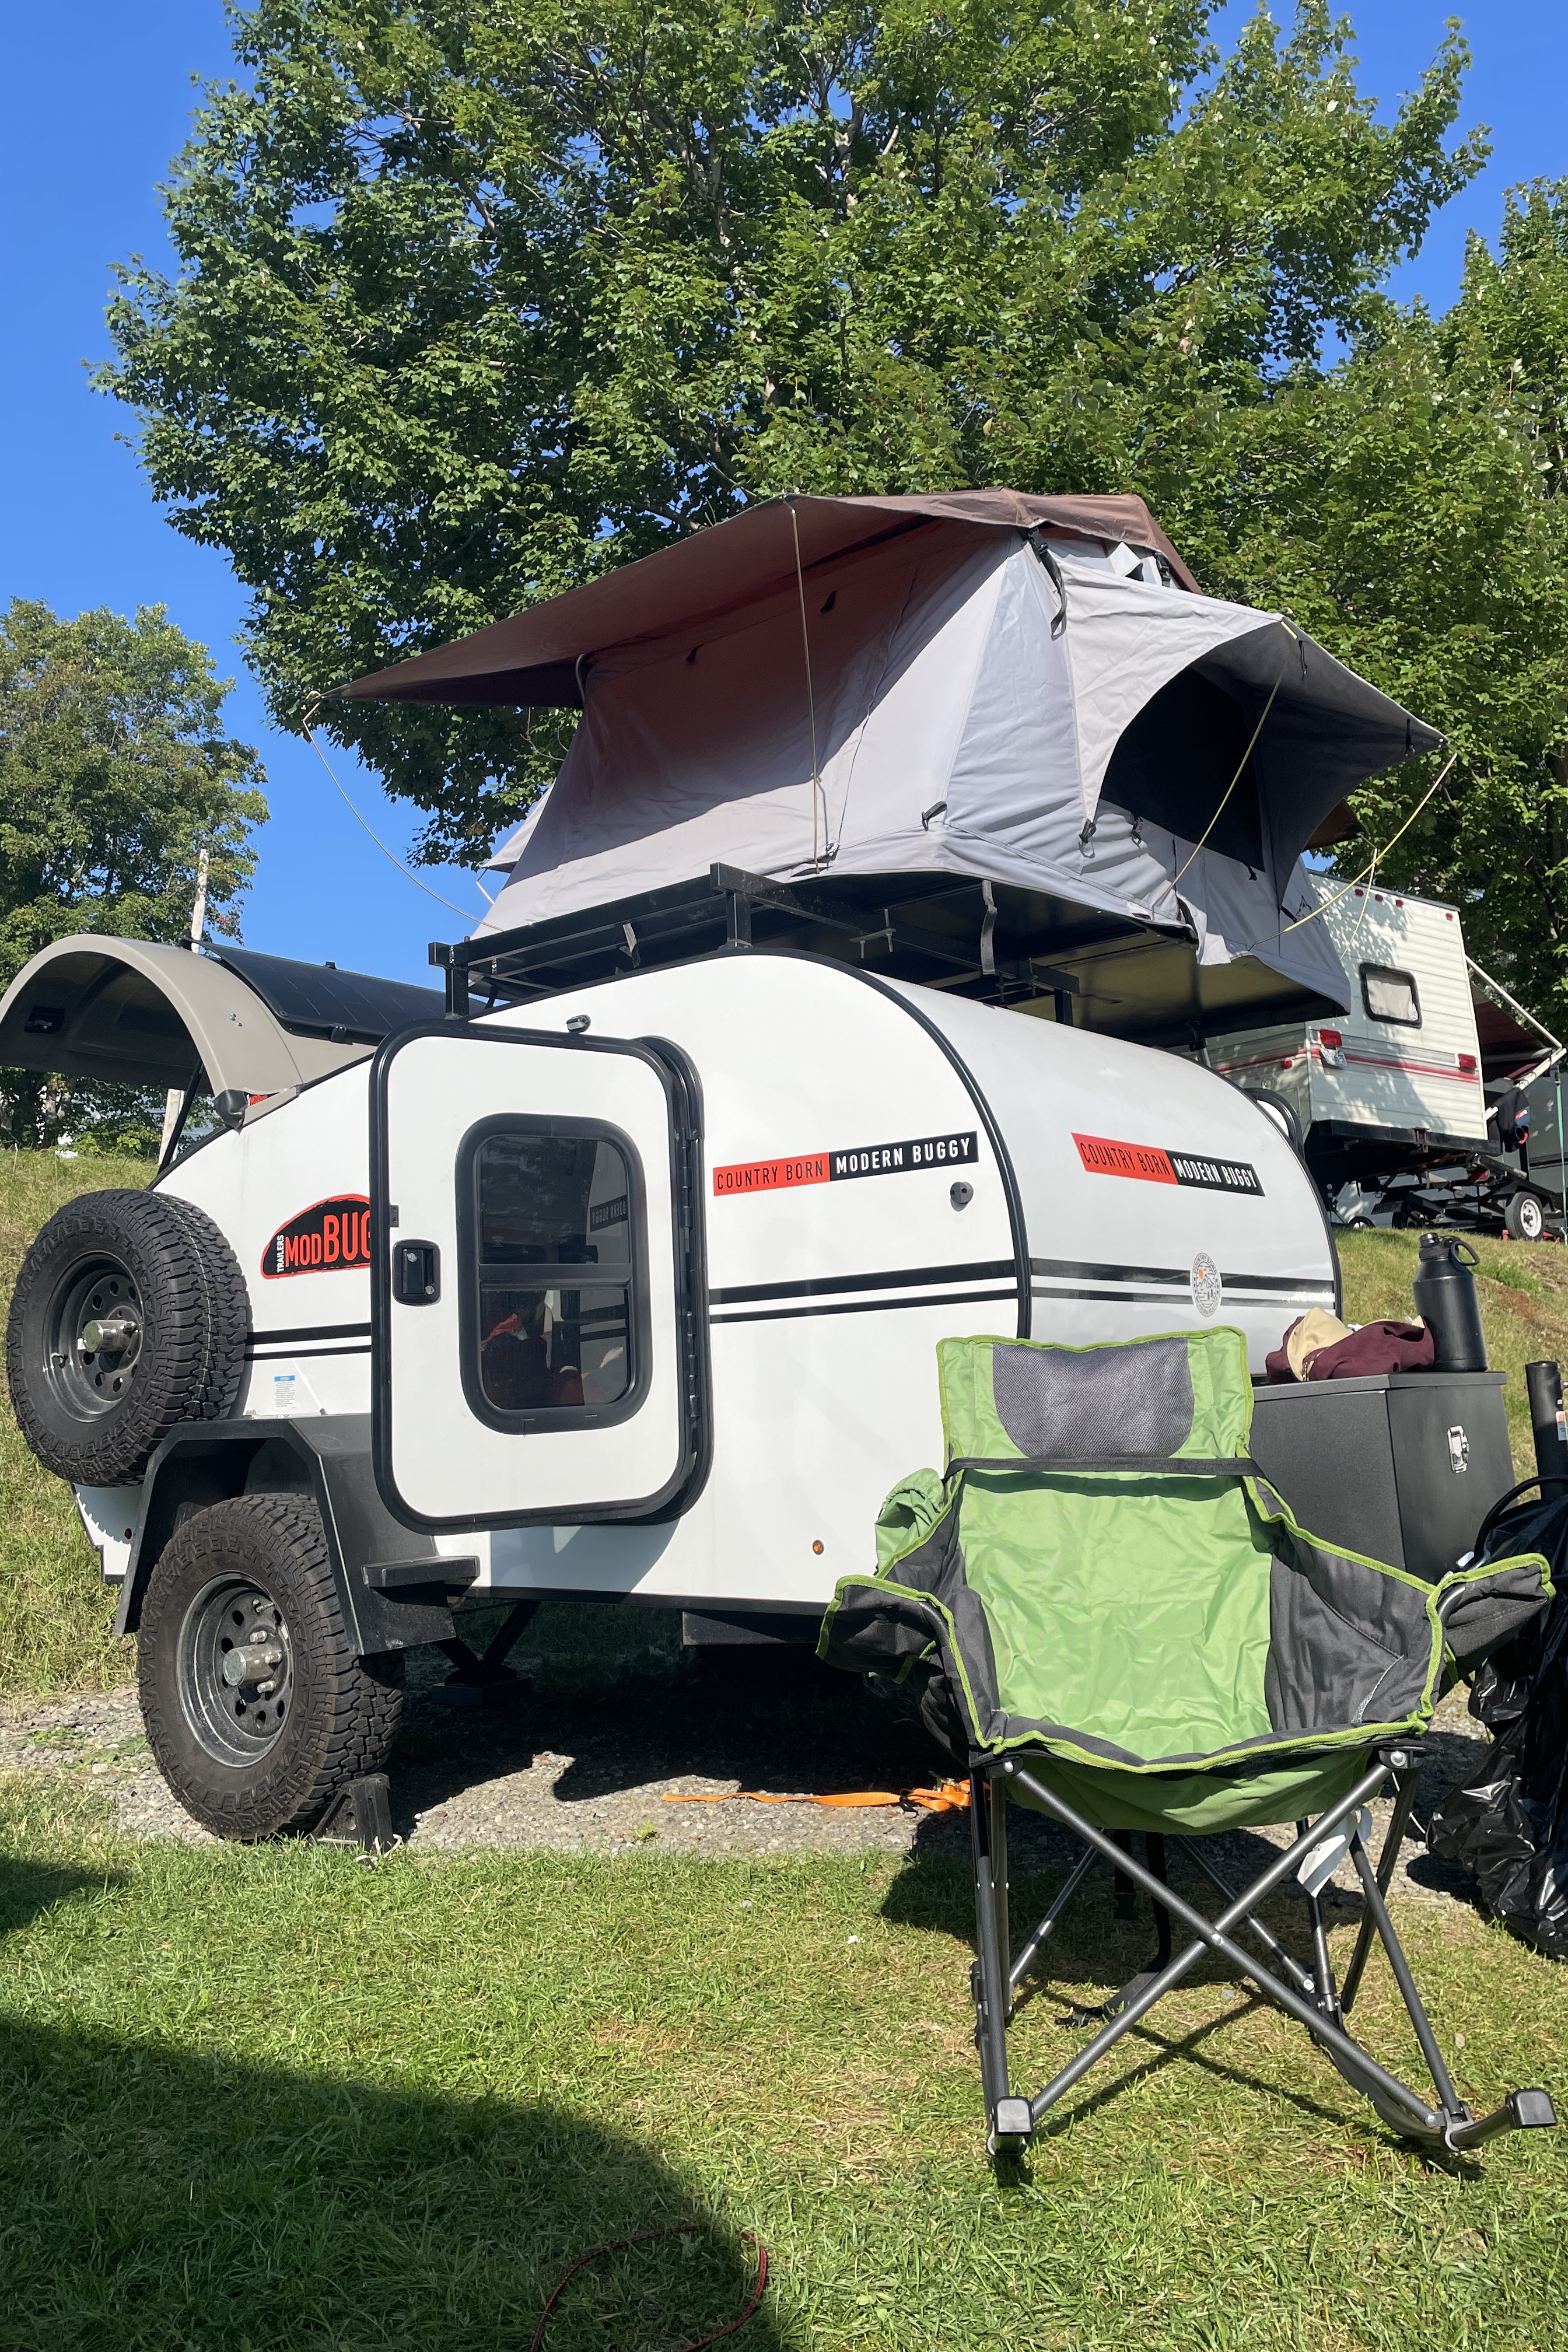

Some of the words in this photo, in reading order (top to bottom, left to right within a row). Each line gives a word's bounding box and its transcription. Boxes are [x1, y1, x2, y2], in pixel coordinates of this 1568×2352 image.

[717, 1166, 779, 1190] COUNTRY
[786, 1159, 824, 1181] BORN
[835, 1147, 904, 1174] MODERN
[912, 1137, 971, 1163] BUGGY
[1079, 1142, 1136, 1171] COUNTRY
[1136, 1152, 1171, 1176] BORN
[1172, 1157, 1223, 1184] MODERN
[1222, 1165, 1258, 1188] BUGGY
[276, 1234, 285, 1273] TRAILERS
